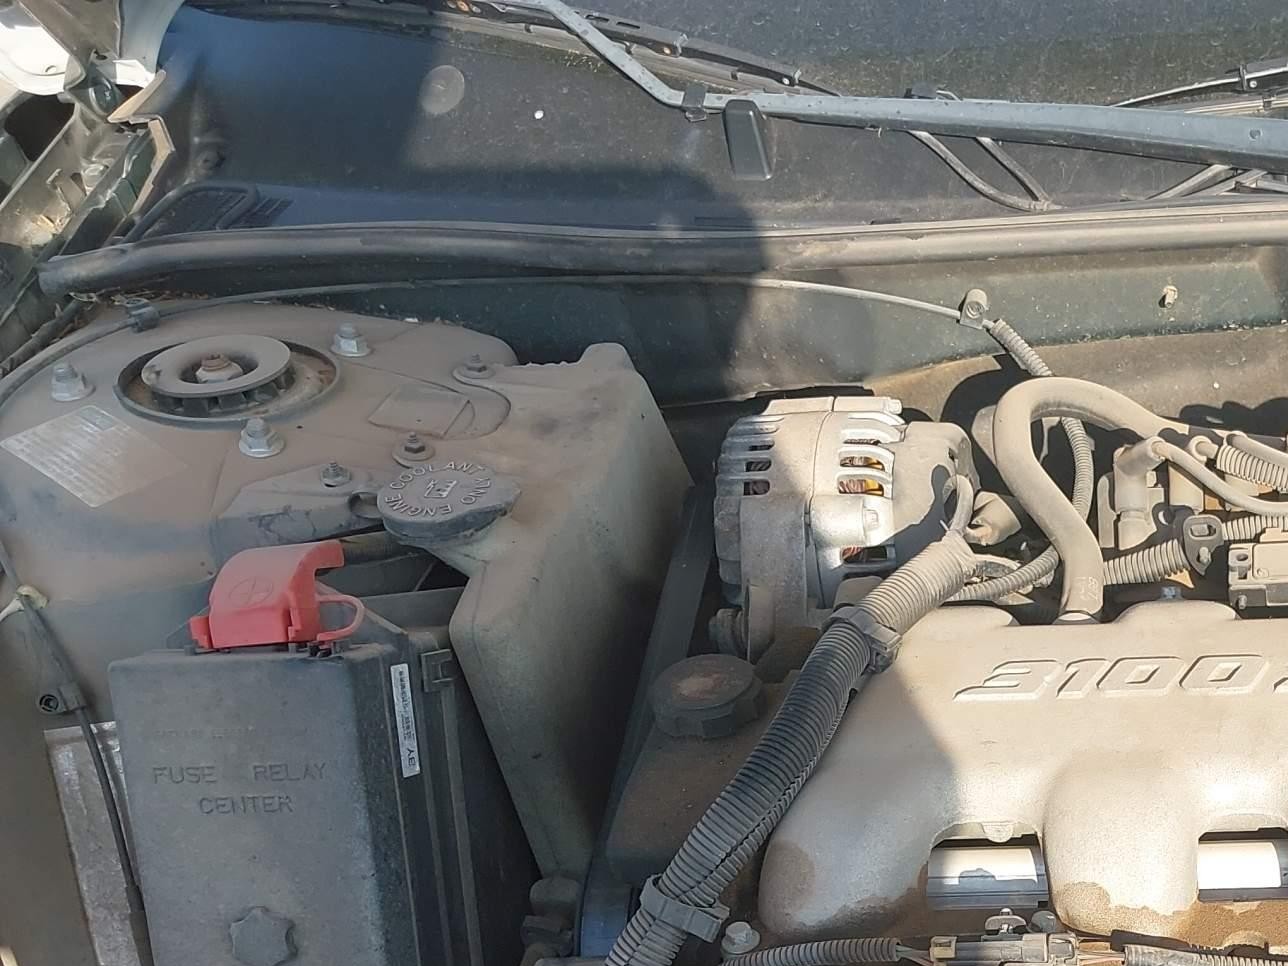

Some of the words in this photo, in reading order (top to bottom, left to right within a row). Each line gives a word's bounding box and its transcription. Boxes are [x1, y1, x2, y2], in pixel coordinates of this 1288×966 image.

[389, 460, 487, 490] COOLANT
[459, 475, 493, 505] ONLY
[383, 492, 454, 517] ENGINE
[953, 653, 1268, 702] 3100
[152, 764, 218, 784] FUSE
[251, 761, 327, 782] RELAY
[198, 794, 294, 815] CENTER
